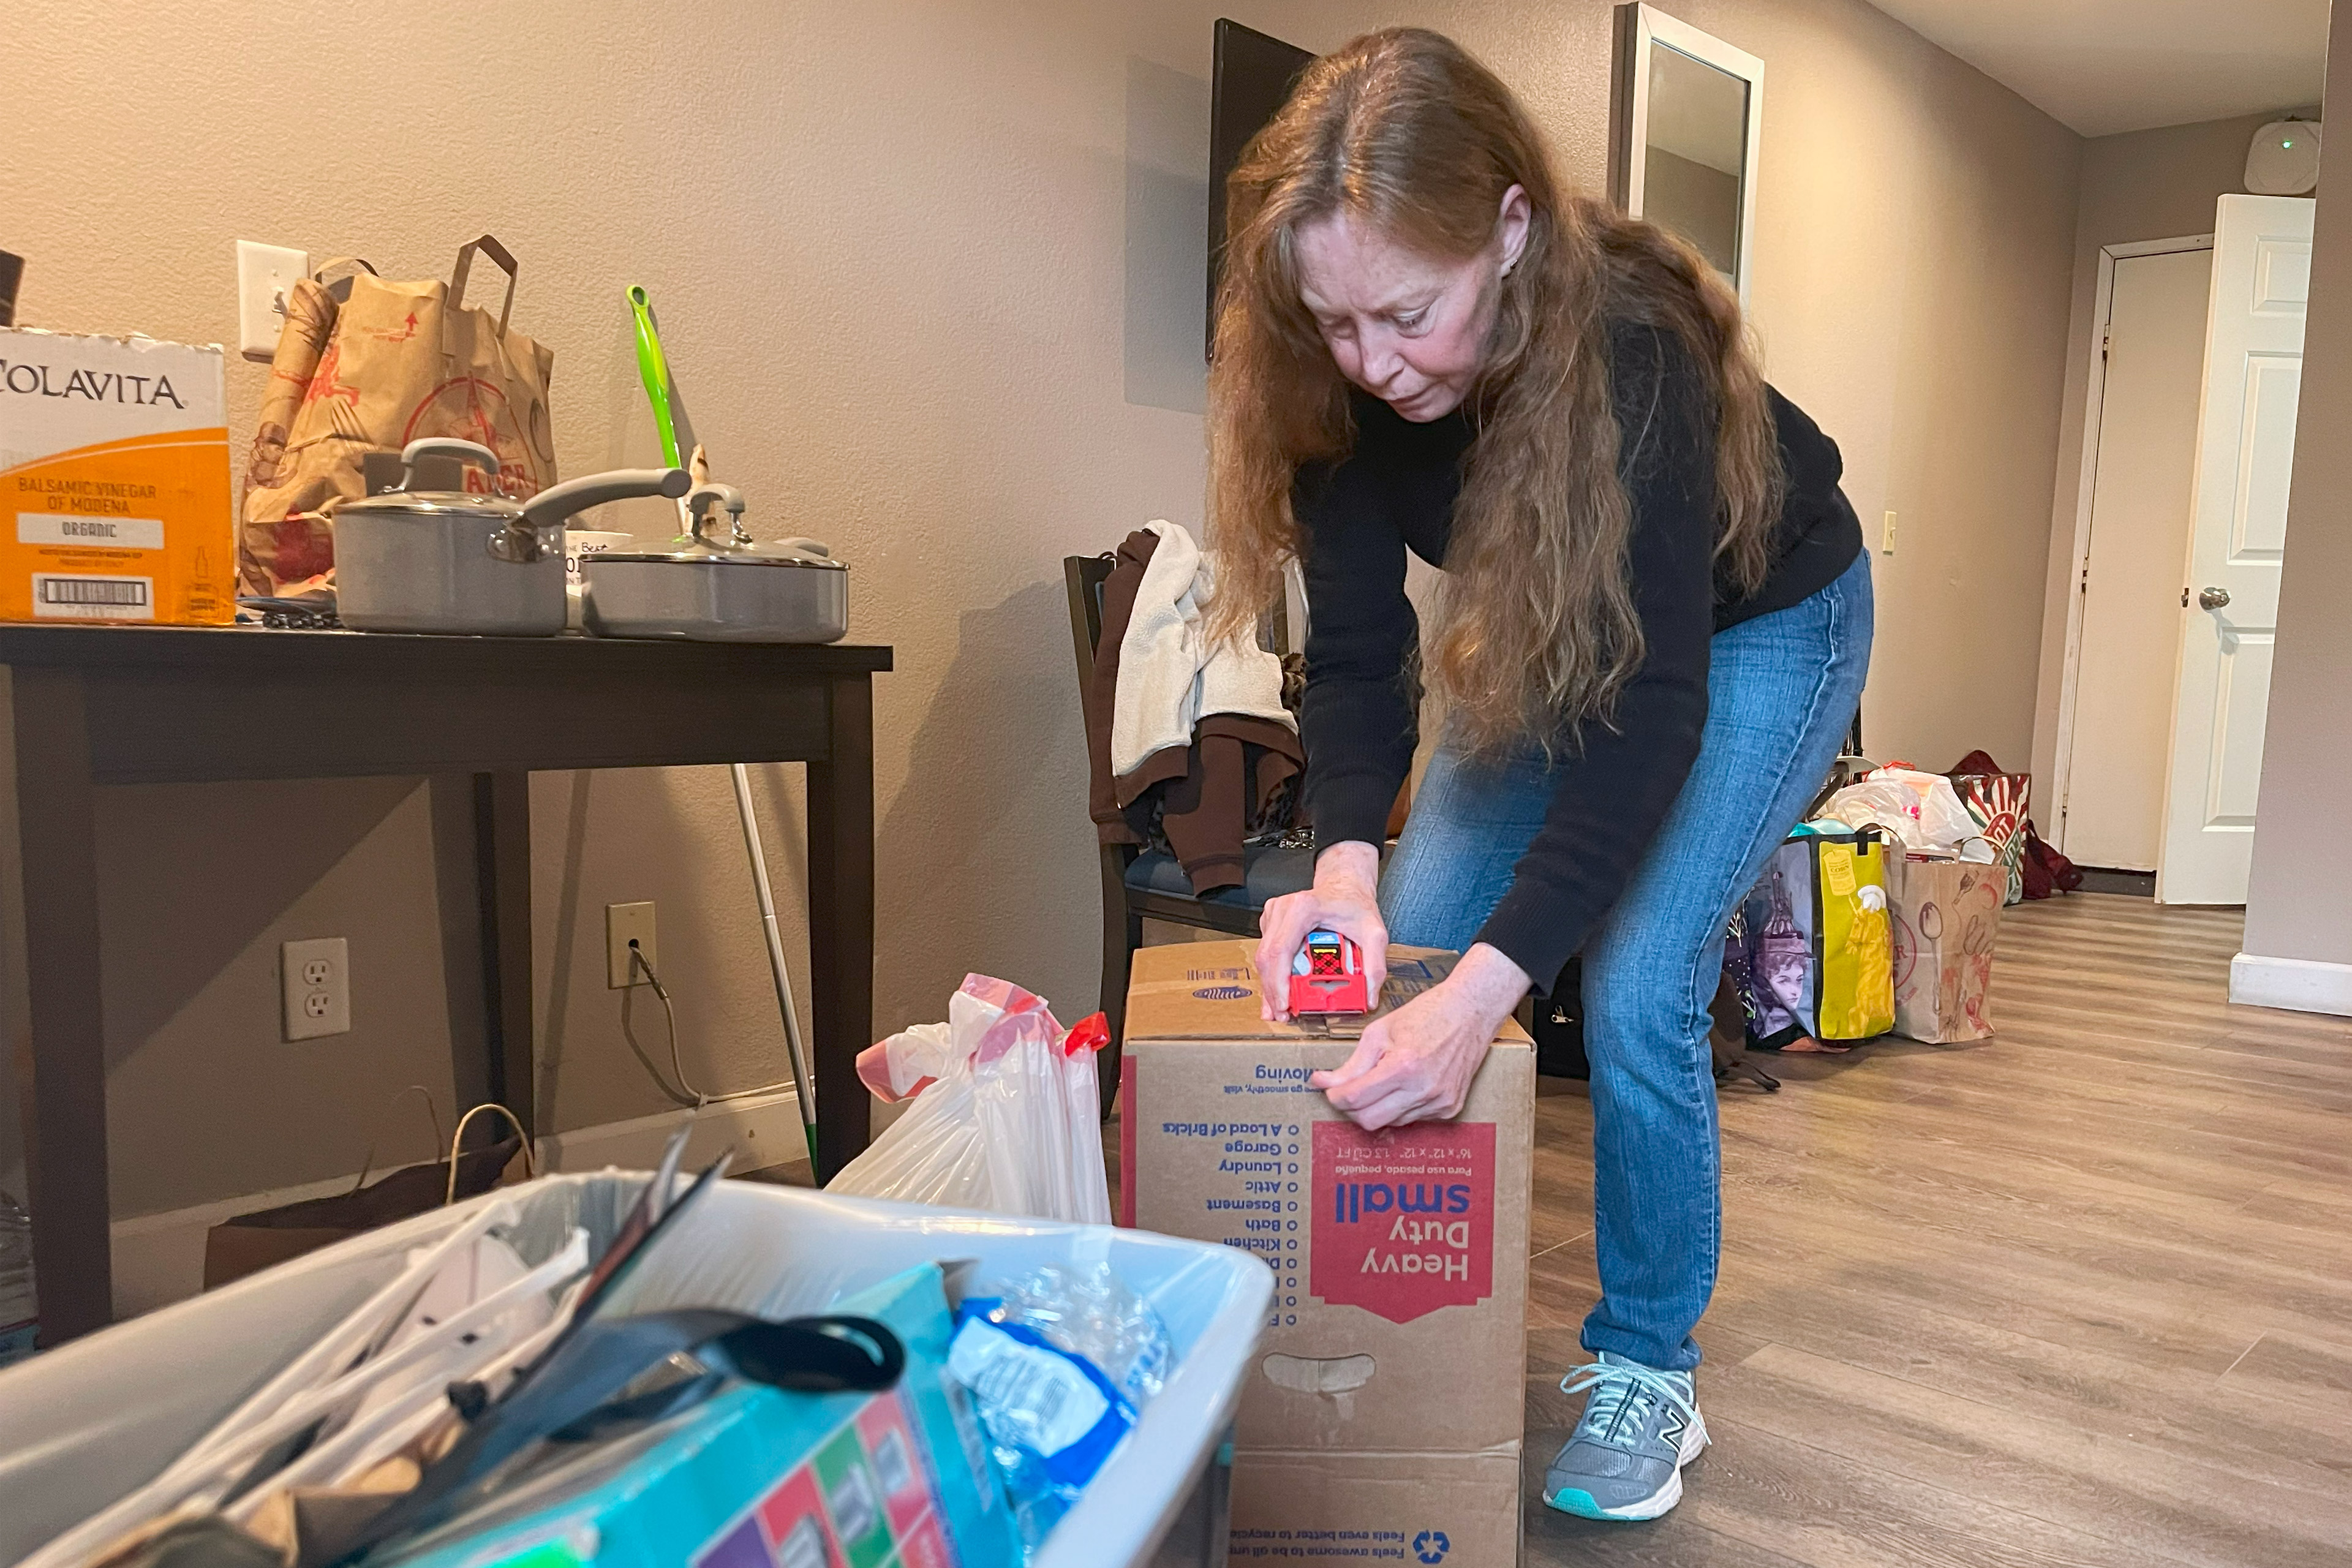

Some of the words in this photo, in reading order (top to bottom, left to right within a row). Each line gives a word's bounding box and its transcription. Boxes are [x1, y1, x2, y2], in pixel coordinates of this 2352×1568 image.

[0, 359, 186, 409] OLAVITA
[19, 478, 90, 494] BALSAMIC
[95, 482, 156, 499] VINEGAR
[48, 496, 66, 510] OF
[70, 497, 130, 513] MODENA
[62, 521, 117, 537] ORGANIC
[1163, 1123, 1208, 1136] Bricks
[1211, 1123, 1227, 1136] of
[1230, 1124, 1267, 1136] Load
[1270, 1124, 1282, 1136] A
[1225, 1140, 1281, 1156] Garage
[1218, 1159, 1281, 1175] Laundry
[1335, 1164, 1382, 1175] pequeña
[1384, 1165, 1425, 1175] pesado,
[1447, 1167, 1472, 1176] Para
[1245, 1181, 1281, 1194] Attic
[1206, 1199, 1281, 1213] Basement
[1336, 1183, 1471, 1223] small
[1246, 1219, 1281, 1232] Bath
[1389, 1215, 1469, 1249] Duty
[1224, 1238, 1281, 1251] Kitchen
[1360, 1247, 1468, 1281] Heavy
[1279, 1531, 1292, 1540] to
[1295, 1531, 1336, 1542] better
[1339, 1531, 1370, 1539] even
[1373, 1531, 1405, 1542] Feels
[1253, 1546, 1268, 1557] all
[1272, 1547, 1287, 1557] be
[1291, 1547, 1304, 1557] to
[1308, 1547, 1368, 1556] awesome
[1372, 1548, 1404, 1559] Feels
